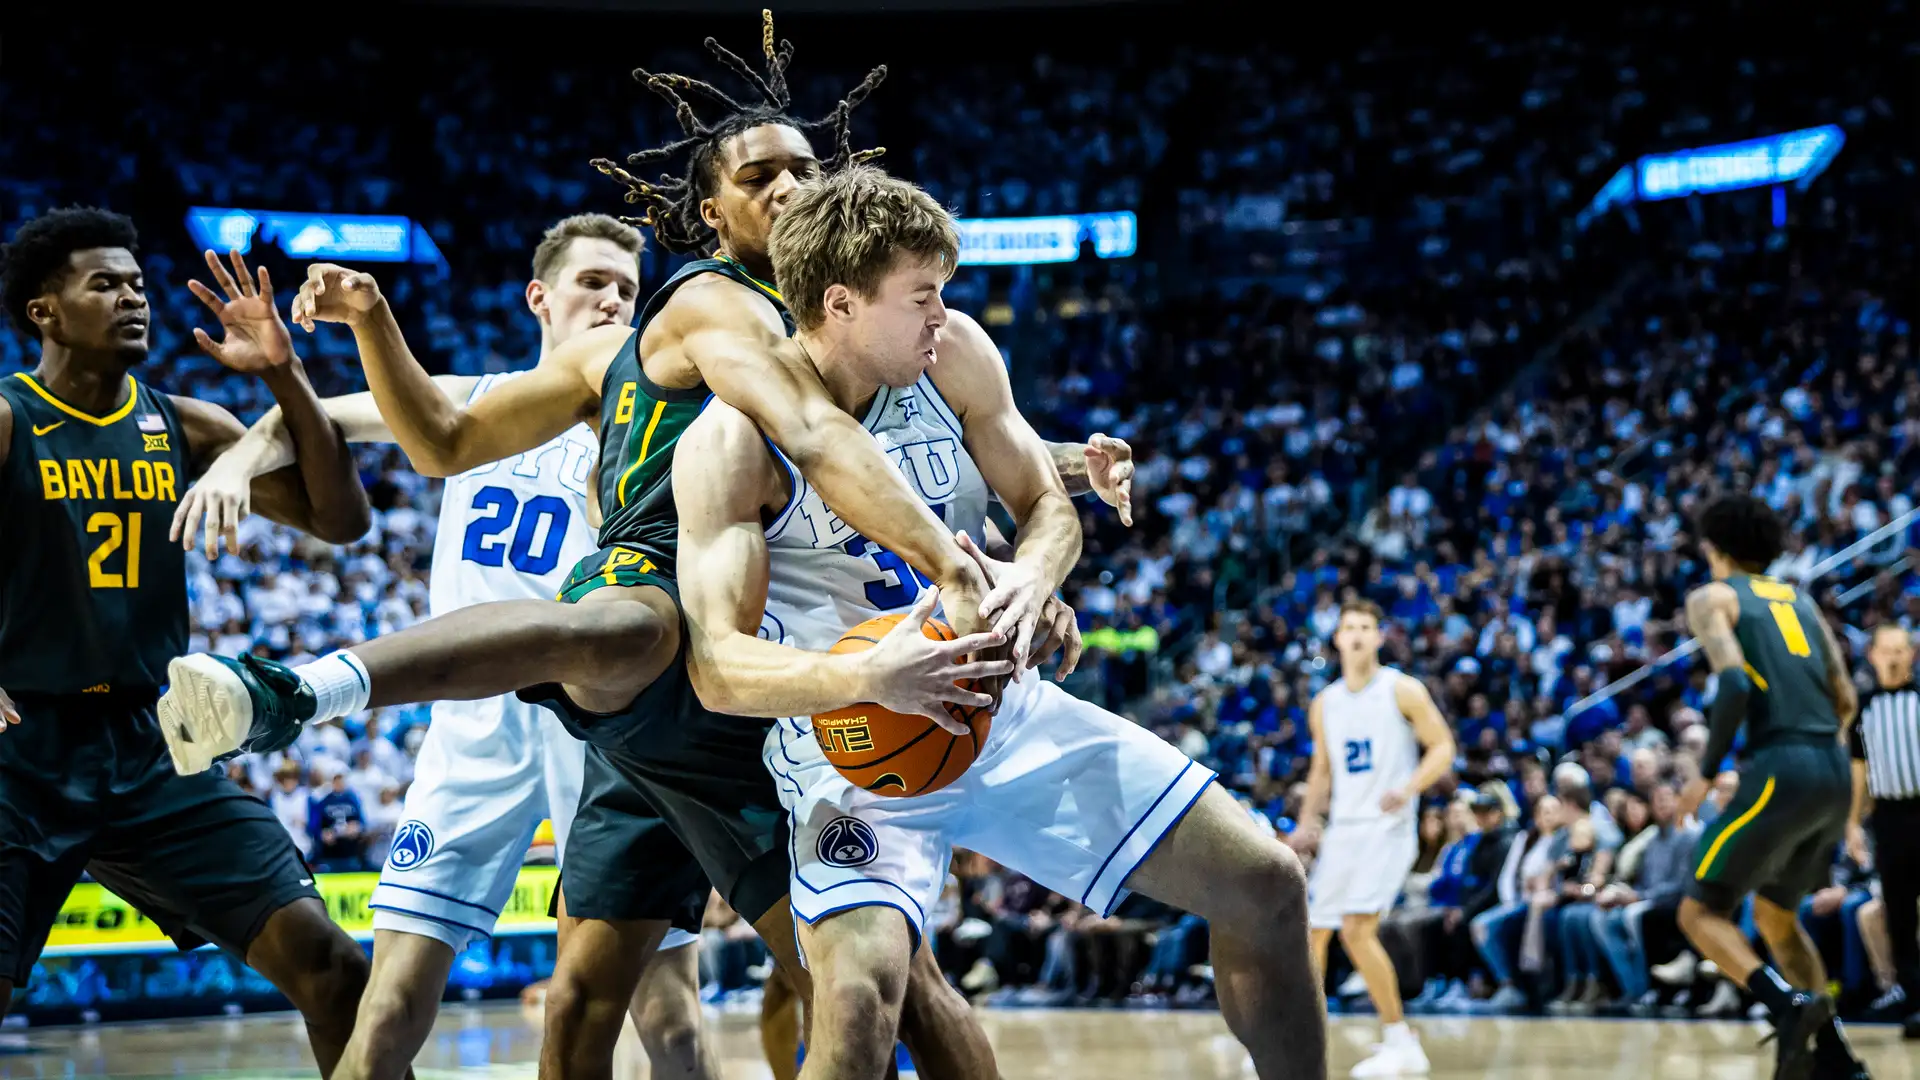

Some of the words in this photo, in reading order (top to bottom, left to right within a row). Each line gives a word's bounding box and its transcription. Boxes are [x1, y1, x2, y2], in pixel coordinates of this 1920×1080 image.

[39, 459, 177, 502] BAYLOR
[86, 512, 141, 588] 21
[462, 485, 571, 576] 20
[1344, 739, 1371, 773] 21
